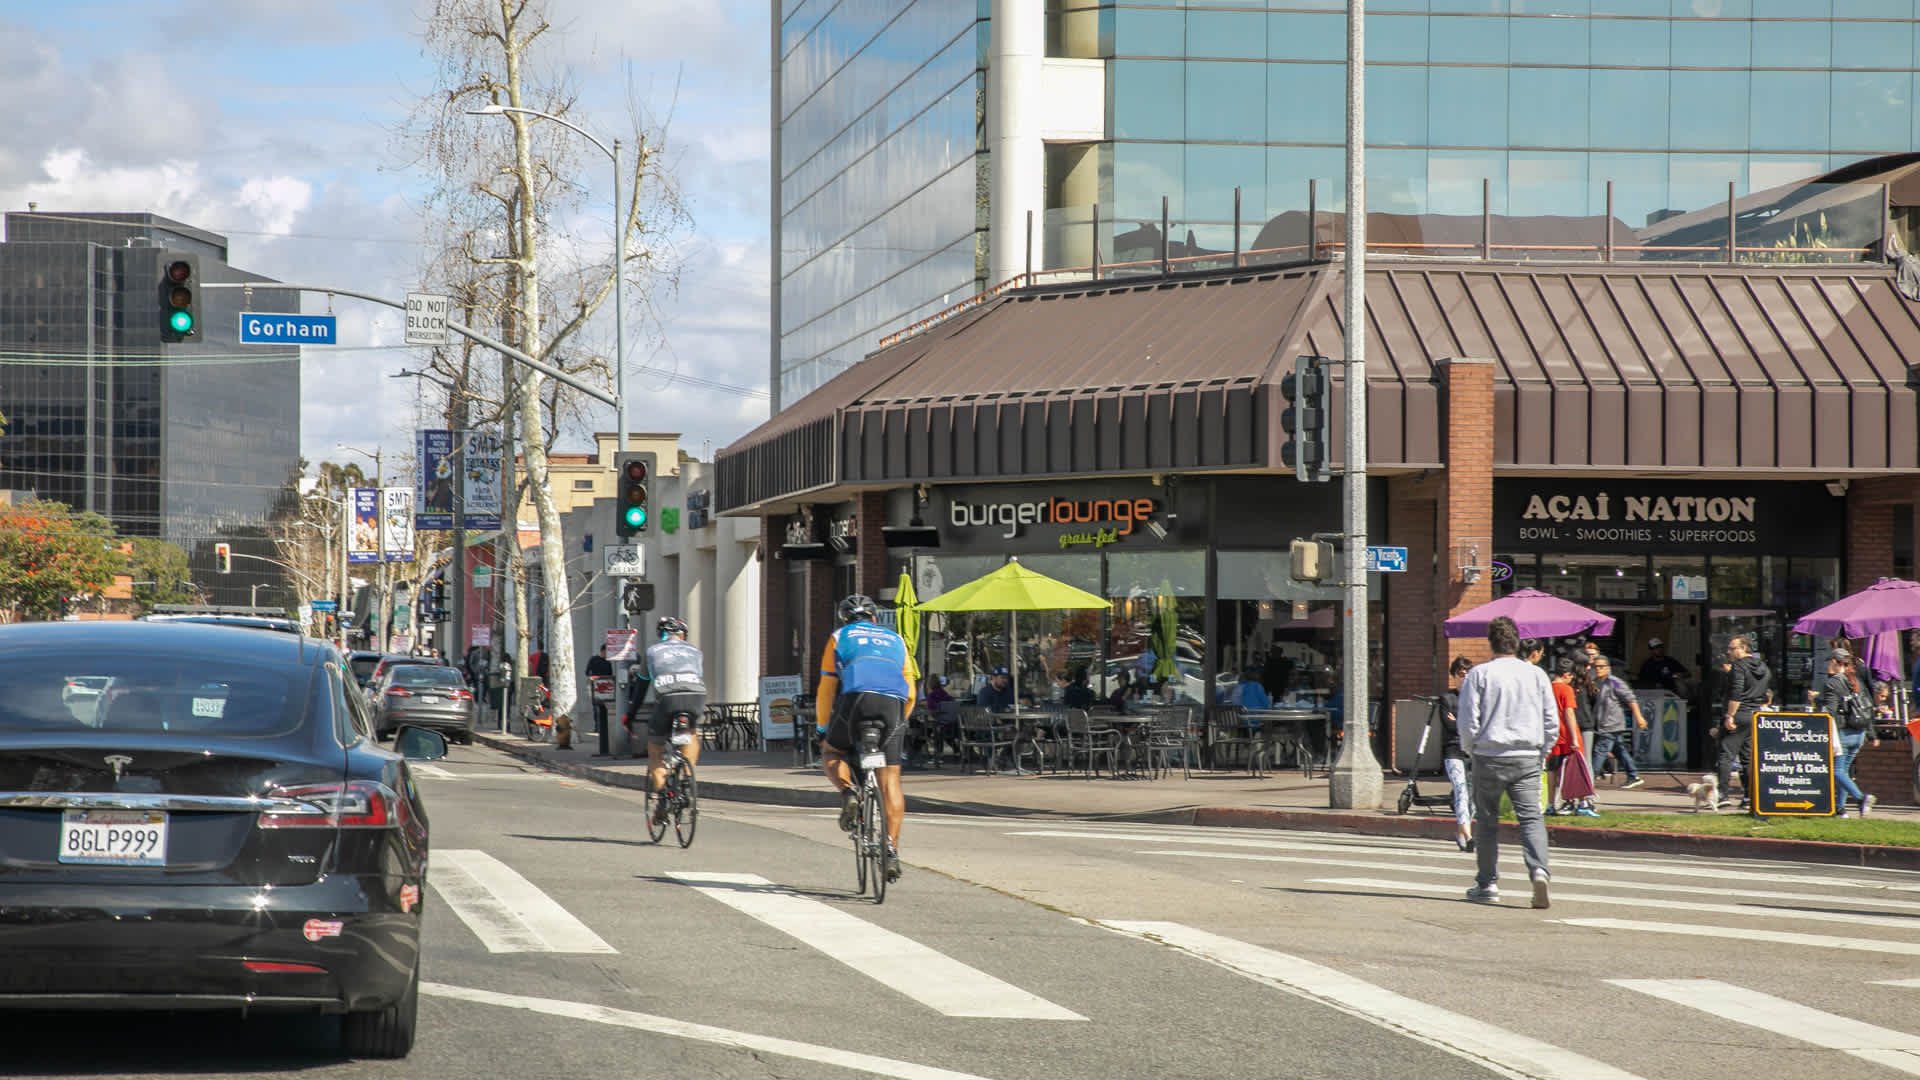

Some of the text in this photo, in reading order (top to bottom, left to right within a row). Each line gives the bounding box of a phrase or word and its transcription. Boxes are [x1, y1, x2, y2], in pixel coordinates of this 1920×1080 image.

[408, 300, 446, 313] DO NOT
[249, 319, 329, 337] Gorham
[407, 316, 444, 329] BLOCK
[1624, 496, 1756, 522] NATION
[1059, 527, 1118, 549] grass-fed
[1519, 527, 1559, 540] BOWL
[1576, 527, 1652, 541] SMOOTHIES
[1669, 529, 1757, 543] SUPERFOODS
[1377, 548, 1399, 561] Vicente
[1758, 716, 1803, 733] Jacques
[1781, 730, 1829, 743] Jewelers
[1763, 751, 1824, 762] Expert Watch,
[1760, 763, 1829, 774] Jewelry & Clock
[1778, 775, 1812, 786] Repairs
[68, 829, 159, 852] 8GLP999
